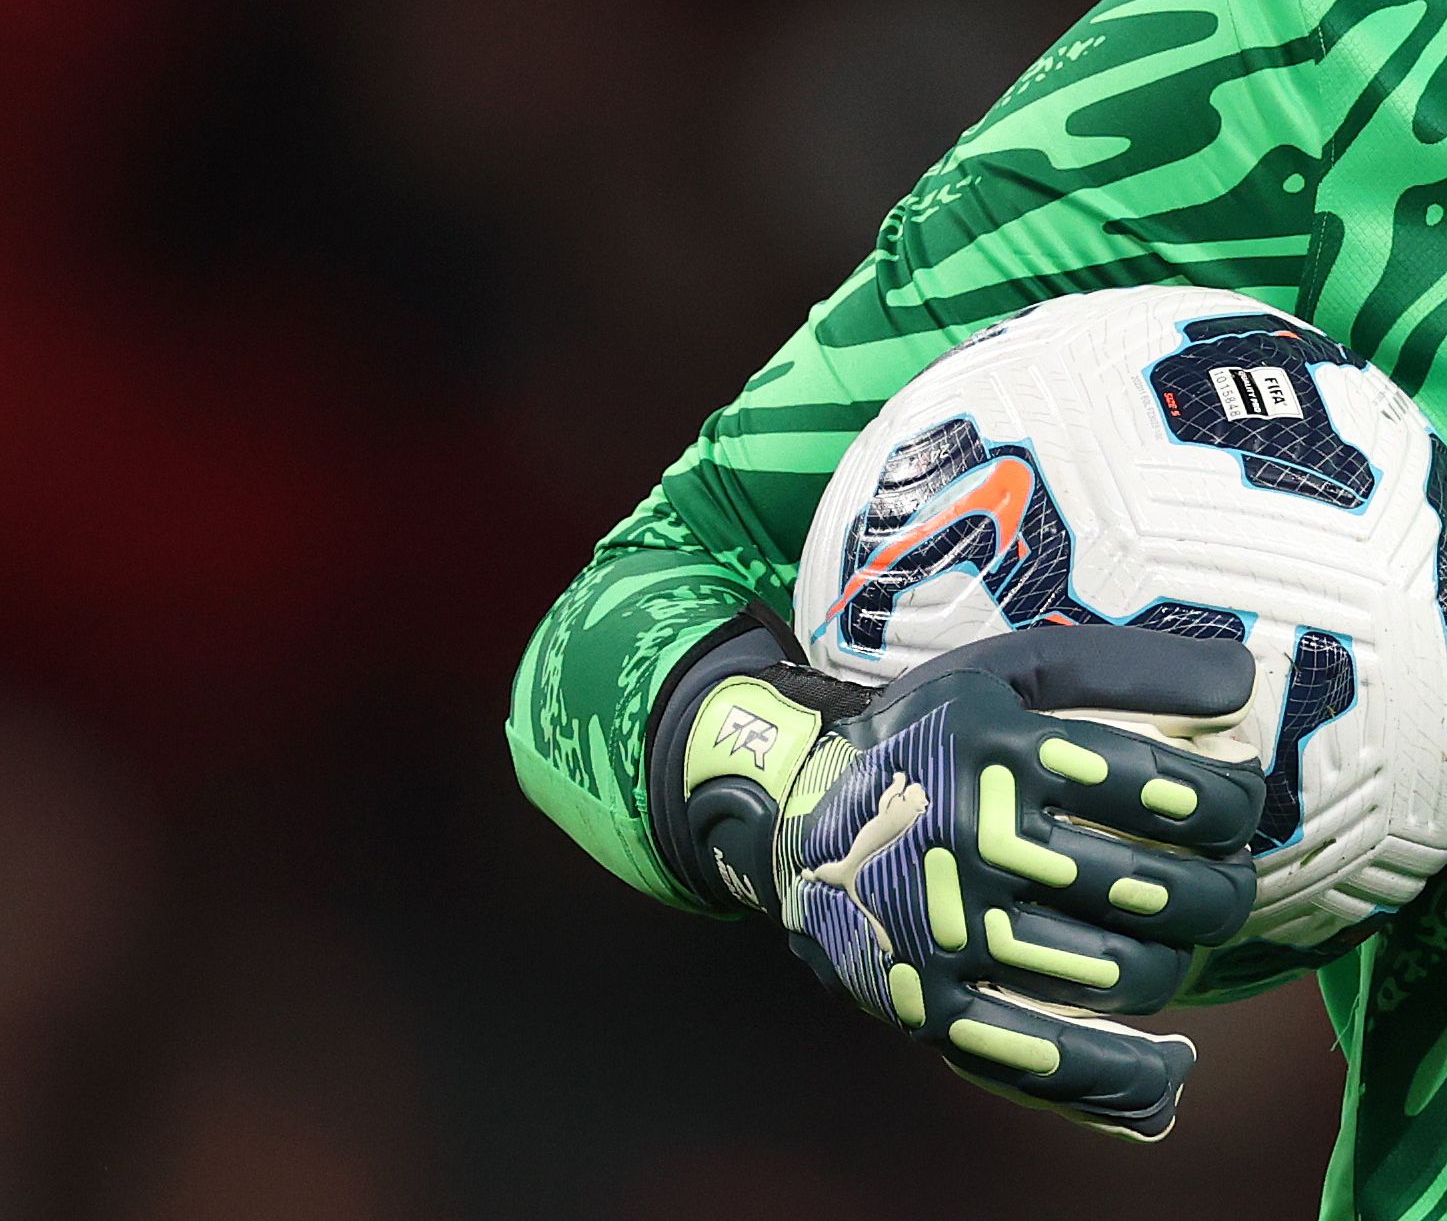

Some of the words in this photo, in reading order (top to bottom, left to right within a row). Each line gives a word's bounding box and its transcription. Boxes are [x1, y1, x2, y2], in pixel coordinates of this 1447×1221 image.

[1214, 371, 1241, 418] 1015848
[1238, 370, 1255, 398] QUALITY
[1250, 398, 1261, 413] PRO
[1264, 377, 1286, 405] FIFA
